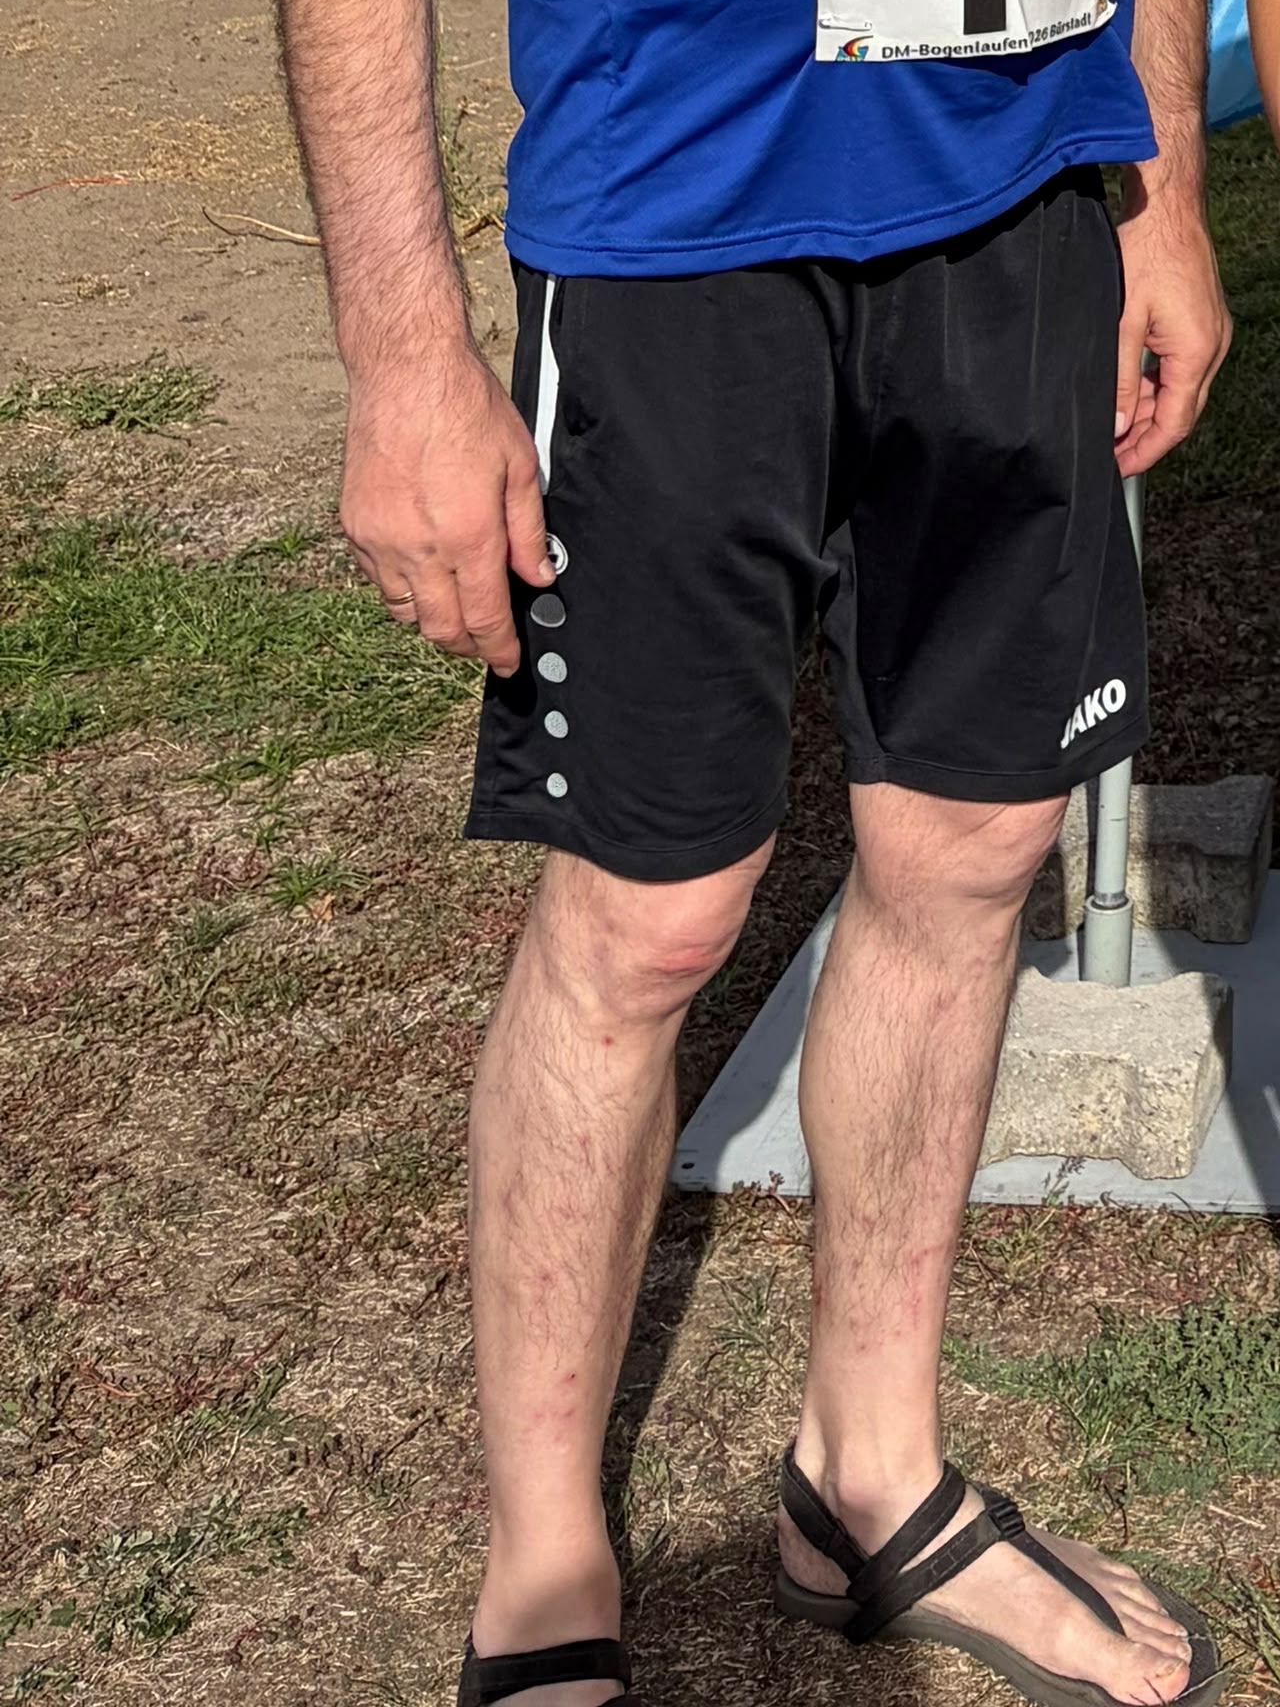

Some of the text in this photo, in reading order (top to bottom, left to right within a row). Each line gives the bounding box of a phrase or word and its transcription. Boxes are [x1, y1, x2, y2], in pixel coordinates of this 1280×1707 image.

[882, 36, 1028, 60] DM-Bogenlaufen
[1049, 12, 1092, 38] Bürstadt
[1060, 678, 1127, 750] JAKO
